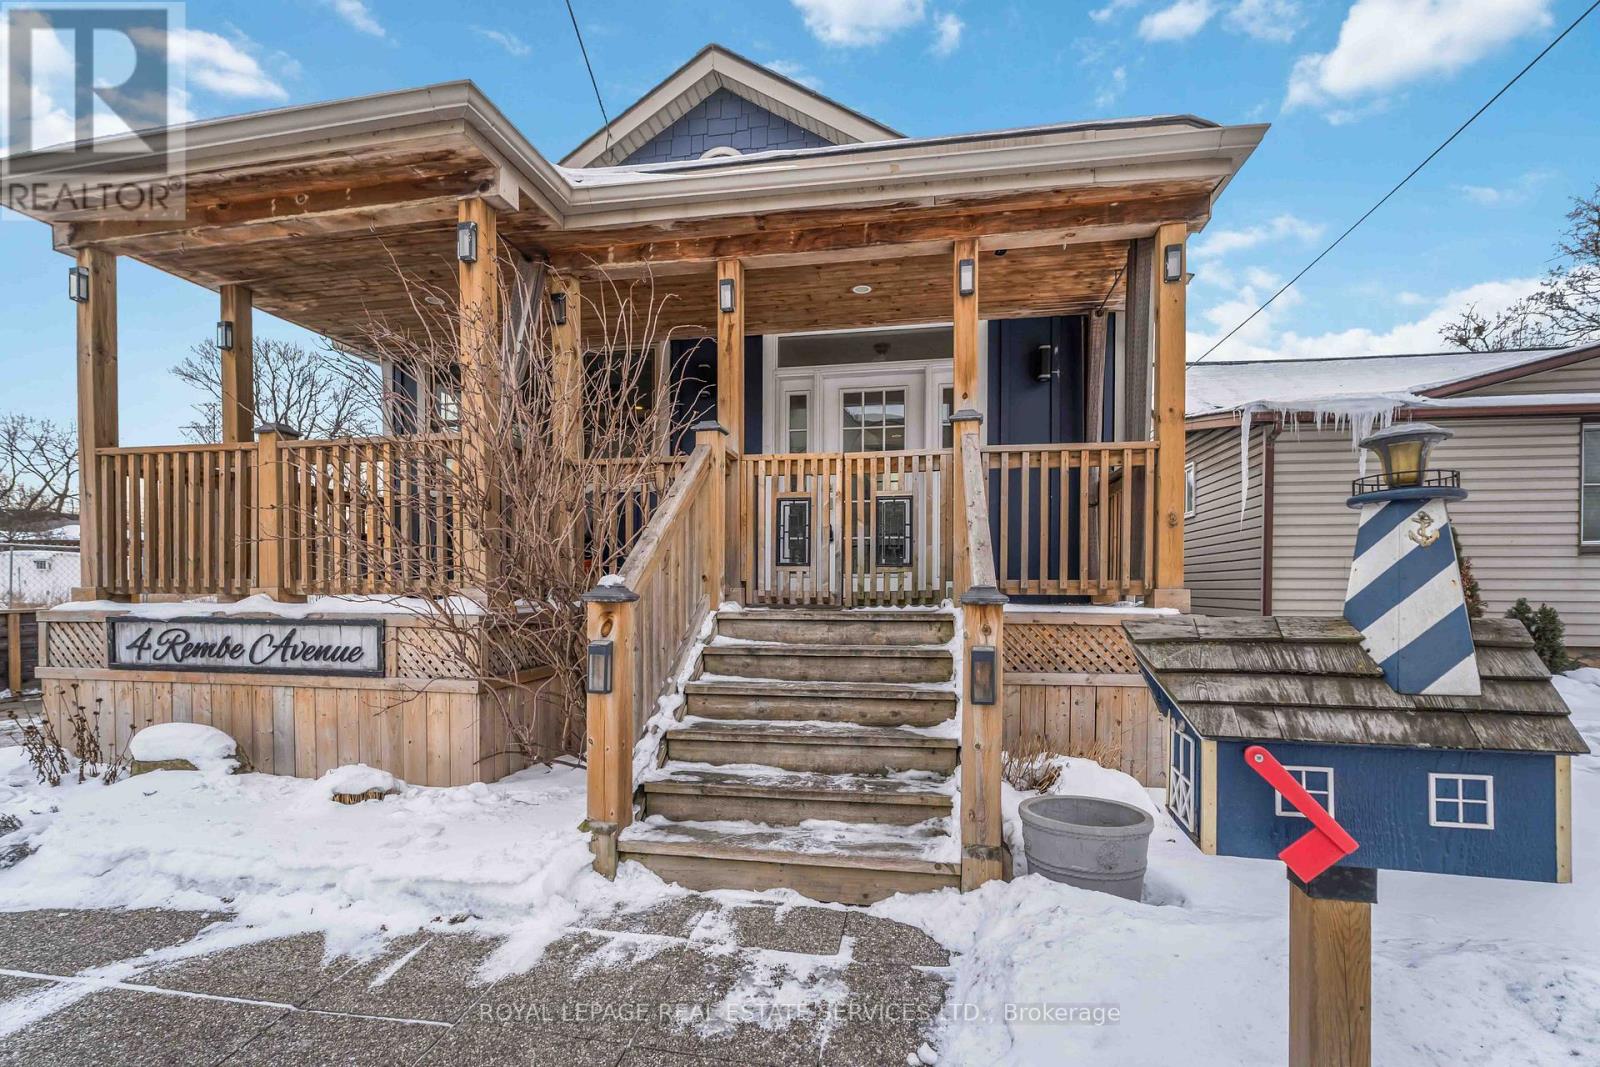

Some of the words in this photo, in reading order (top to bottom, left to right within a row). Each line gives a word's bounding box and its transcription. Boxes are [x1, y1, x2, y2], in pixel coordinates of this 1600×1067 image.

[126, 627, 152, 661] 4
[152, 628, 245, 663] Rembe
[249, 628, 365, 665] Avenue
